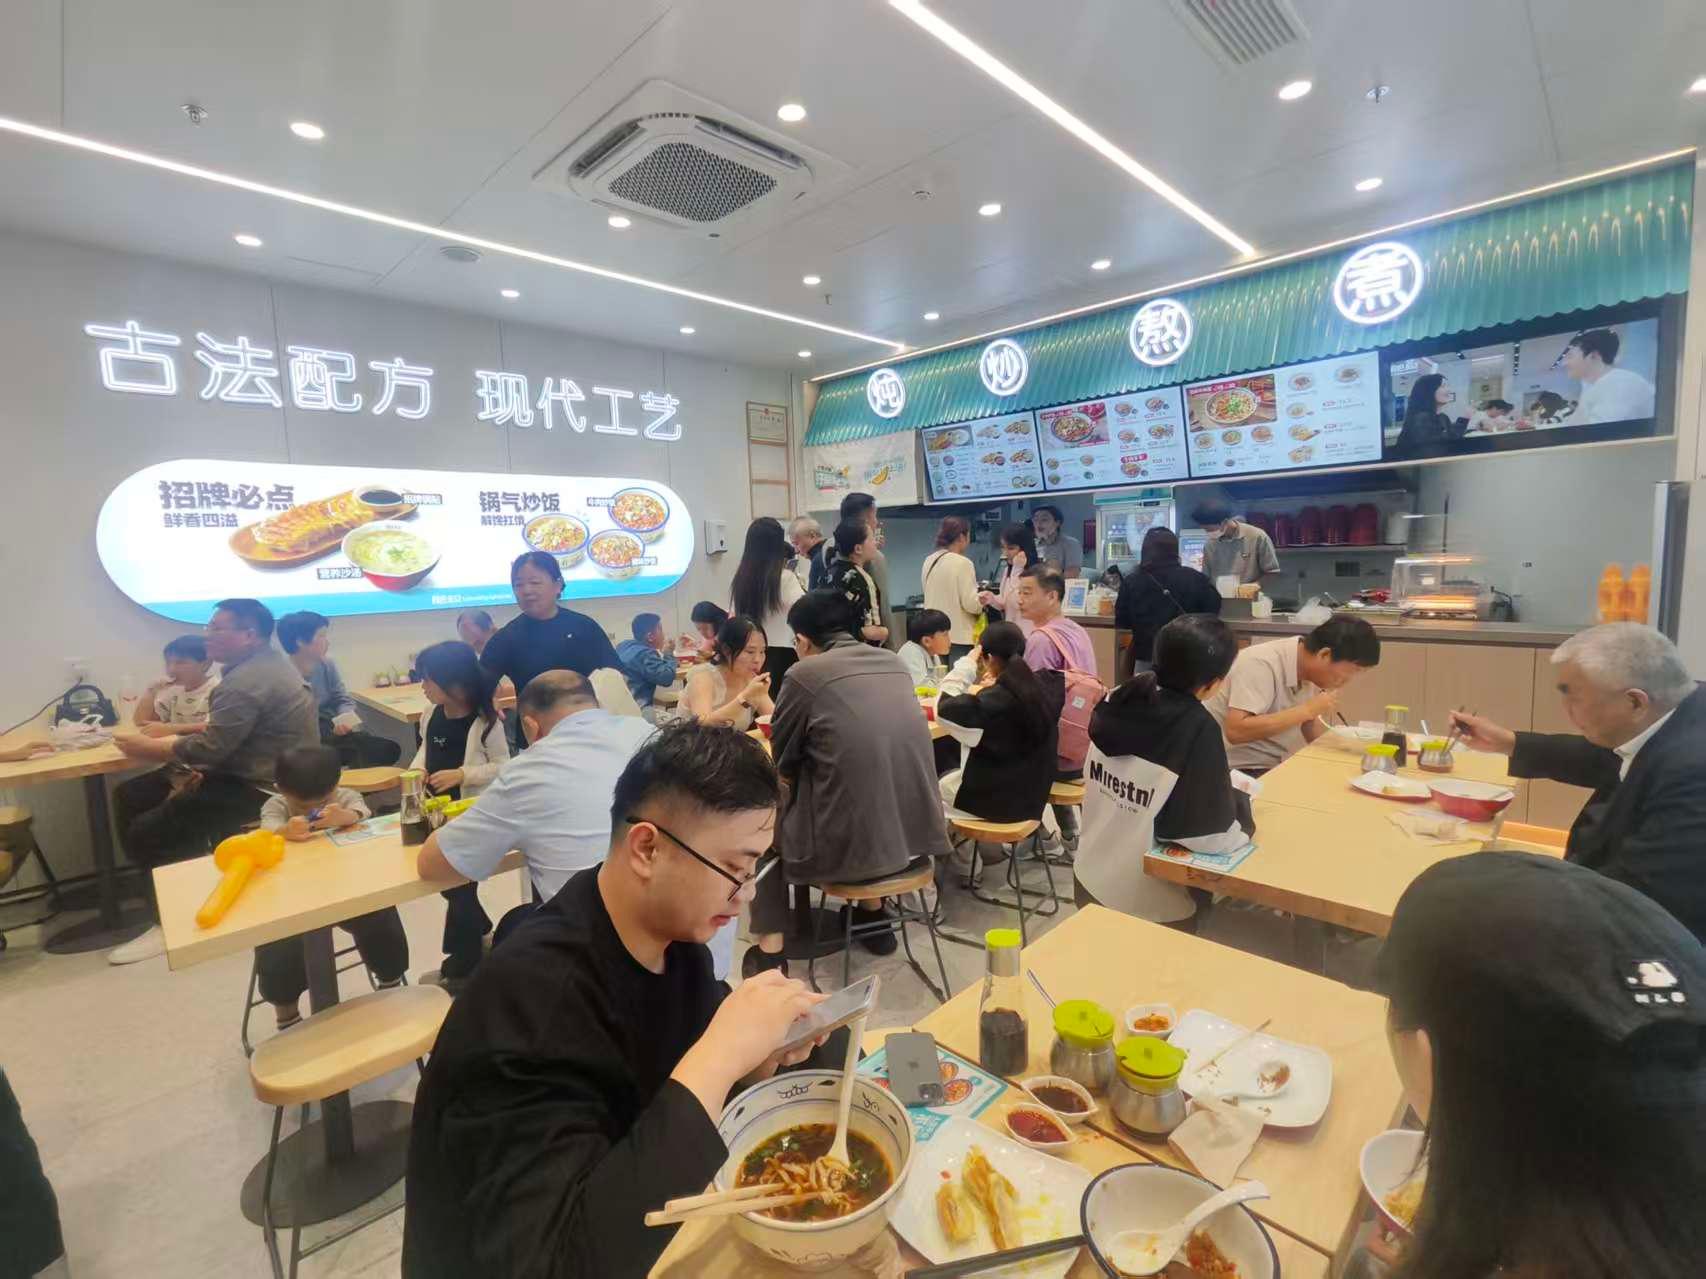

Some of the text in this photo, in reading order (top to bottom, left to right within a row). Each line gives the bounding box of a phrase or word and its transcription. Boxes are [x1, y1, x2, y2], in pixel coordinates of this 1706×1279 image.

[1346, 252, 1409, 316] 煮
[1138, 306, 1184, 355] 熬
[84, 320, 434, 419] 古法配方
[986, 346, 1022, 392] 炒
[474, 369, 682, 441] 现代工艺
[869, 373, 899, 413] 炖
[158, 480, 296, 511] 招牌必点
[479, 491, 560, 512] 锅气炒饭
[163, 512, 239, 528] 鲜香四溢
